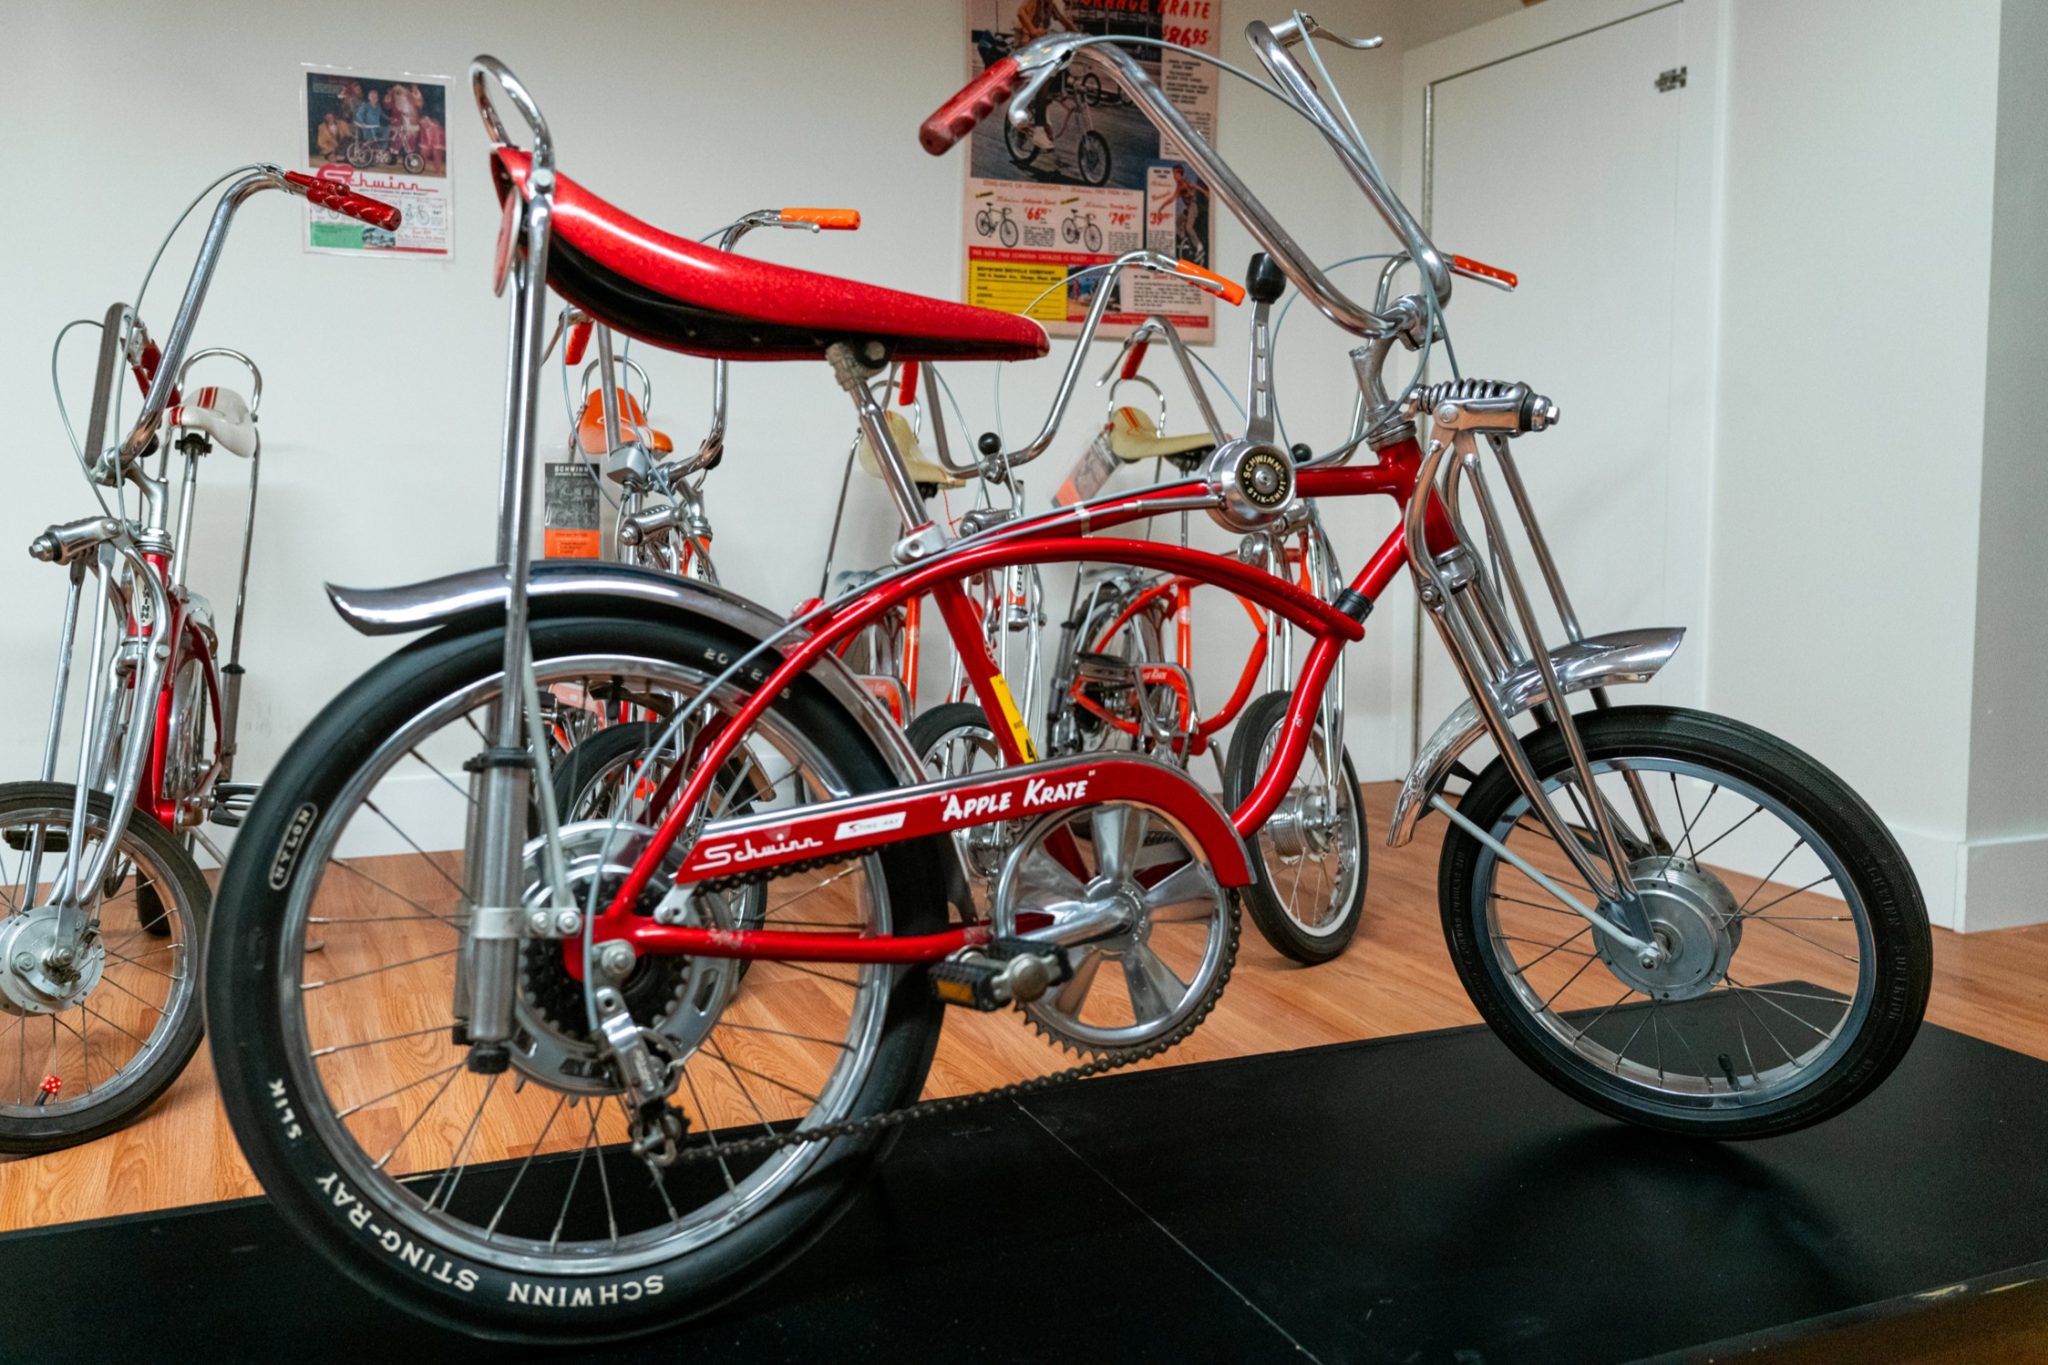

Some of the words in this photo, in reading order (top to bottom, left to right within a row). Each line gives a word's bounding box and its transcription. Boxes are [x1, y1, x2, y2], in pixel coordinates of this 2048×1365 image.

[1157, 0, 1211, 19] KRATE
[1243, 454, 1282, 479] SCHWINN
[703, 648, 729, 665] 20
[274, 808, 311, 880] NYLON
[691, 832, 824, 872] Schwinn
[268, 1077, 303, 1141] SLIK
[315, 1171, 481, 1292] STING-RAY
[507, 1274, 665, 1308] SCHWINN
